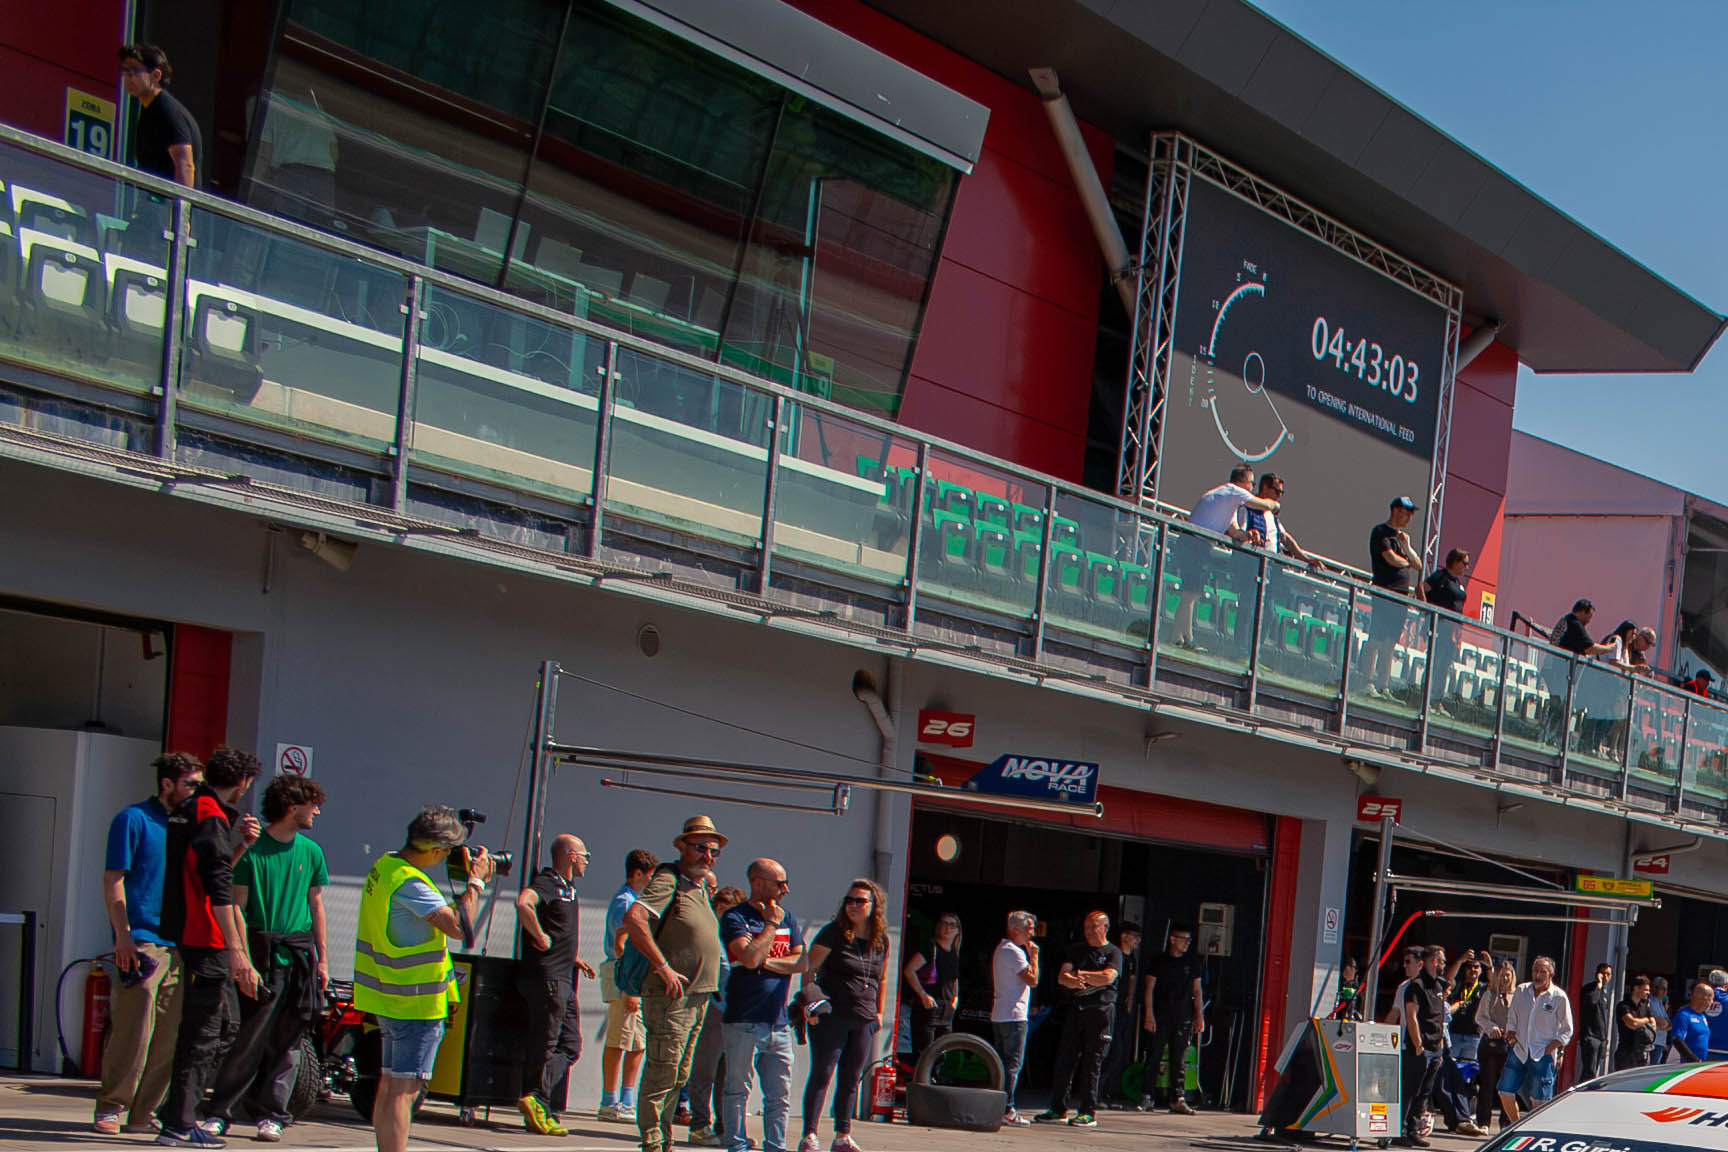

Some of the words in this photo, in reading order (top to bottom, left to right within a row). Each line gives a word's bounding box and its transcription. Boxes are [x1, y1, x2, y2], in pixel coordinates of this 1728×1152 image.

[71, 119, 108, 155] 19
[1311, 316, 1419, 404] 04:43:03
[1306, 384, 1317, 400] TO
[1318, 391, 1346, 414] OPENING
[1348, 403, 1397, 436] INTERNATIONAL
[1398, 425, 1415, 442] FEED
[923, 719, 972, 737] 26
[1000, 757, 1094, 786] NOVA
[1048, 782, 1087, 794] RACE
[1361, 801, 1399, 817] 25
[1636, 854, 1668, 870] 24
[1529, 1137, 1555, 1152] R.
